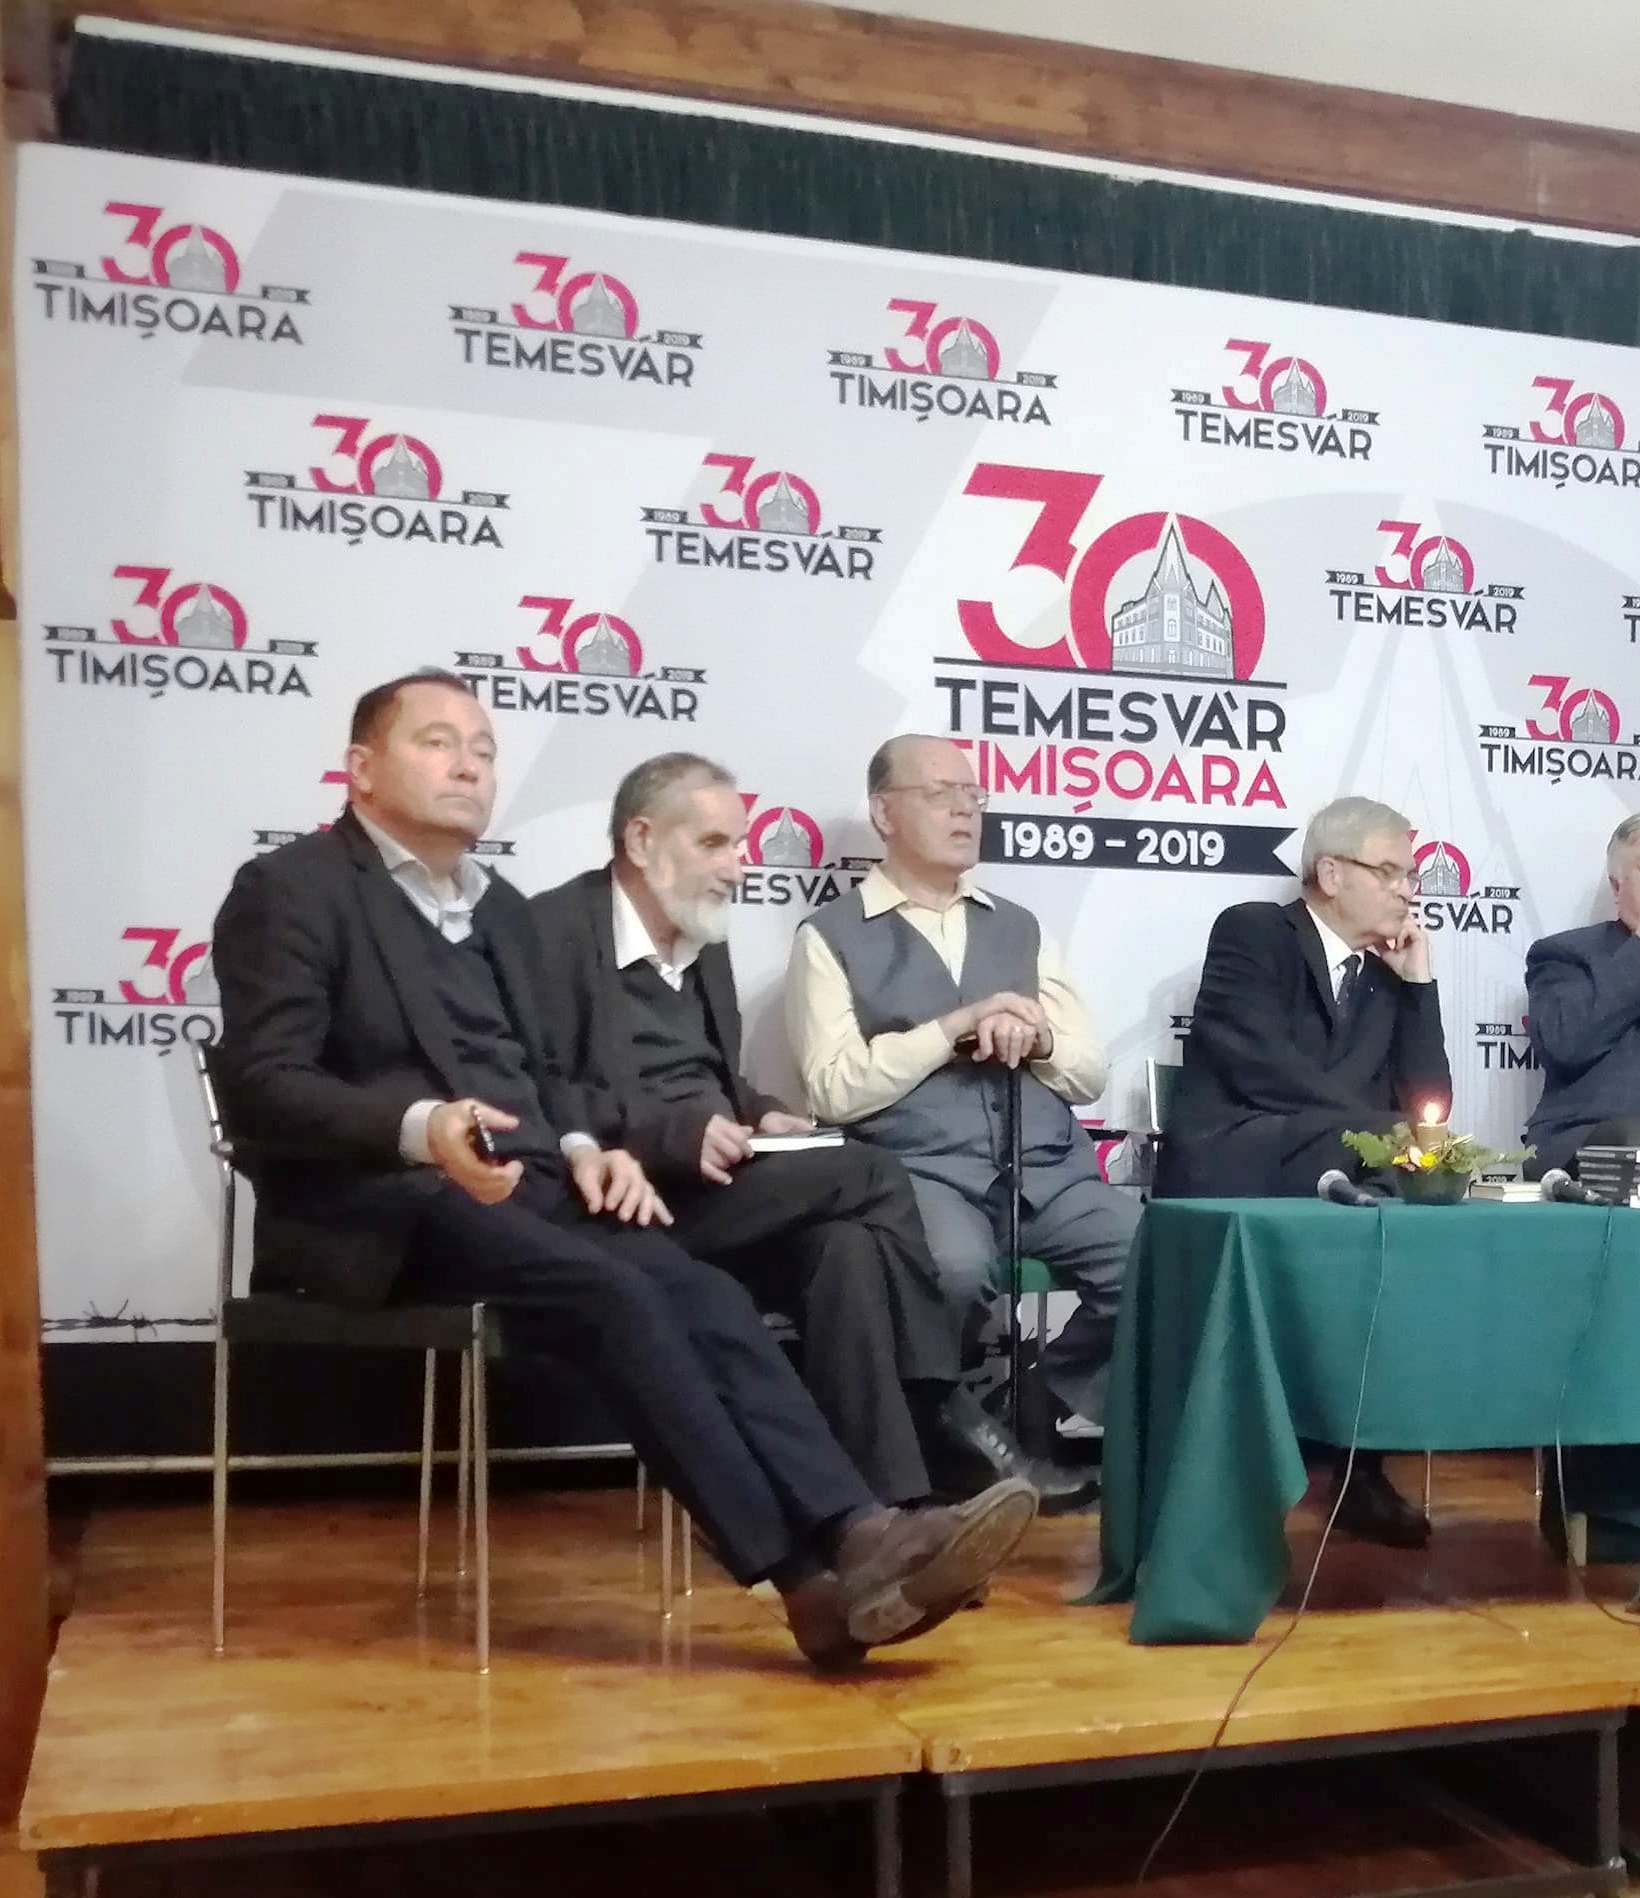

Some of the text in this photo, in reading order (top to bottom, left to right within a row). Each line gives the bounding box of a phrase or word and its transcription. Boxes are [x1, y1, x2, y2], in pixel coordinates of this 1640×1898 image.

[454, 327, 694, 388] TEMESVÁR
[1174, 407, 1373, 461] TEMESVÁR
[1347, 411, 1369, 423] 2019
[645, 526, 875, 581] TEMESVÁR
[957, 462, 1266, 680] 30
[1329, 588, 1518, 635] TEMESVÁR
[1493, 586, 1515, 597] 2019
[1489, 727, 1510, 738] 1989
[1000, 820, 1095, 861] 1989
[1135, 828, 1226, 868] 2019
[1490, 888, 1511, 898] 2019
[55, 1010, 217, 1058] TIMIȘO
